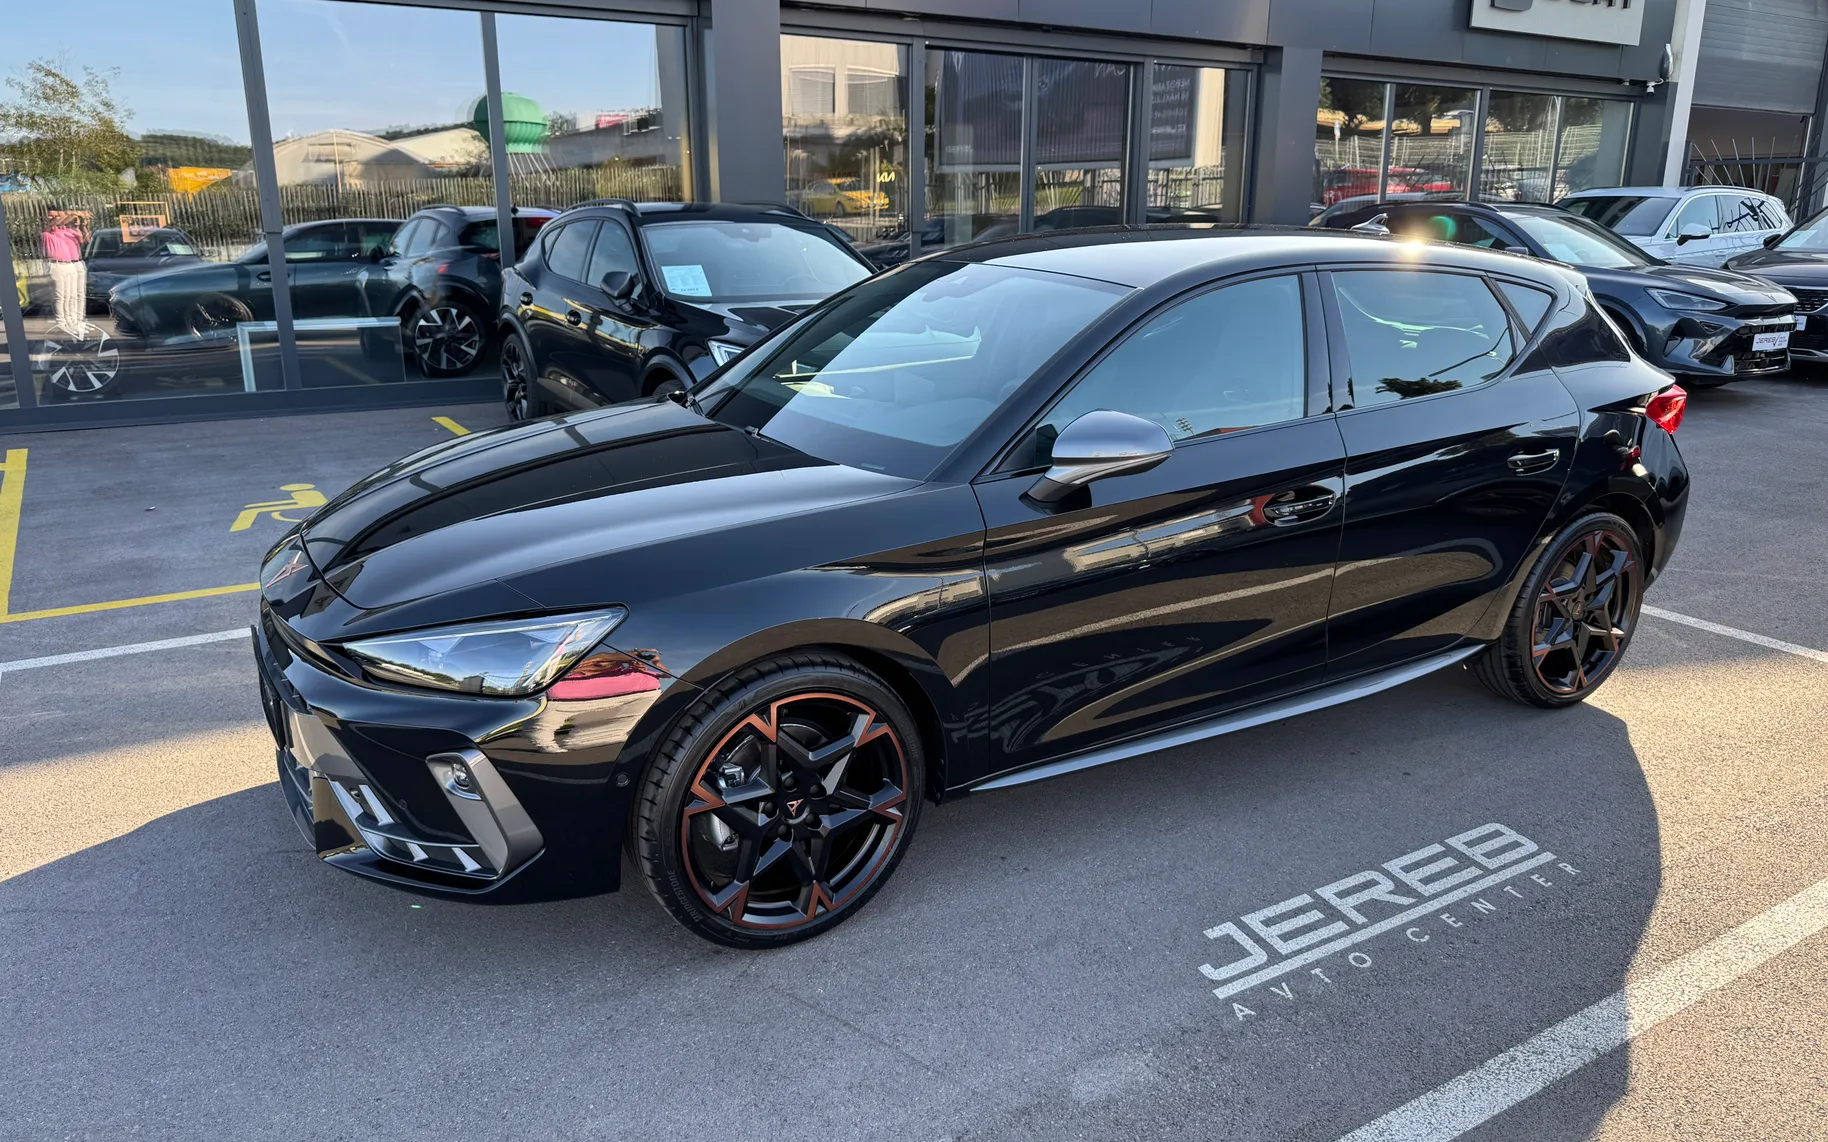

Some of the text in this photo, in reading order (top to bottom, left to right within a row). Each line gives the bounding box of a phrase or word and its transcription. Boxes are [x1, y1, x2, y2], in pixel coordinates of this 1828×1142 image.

[1198, 822, 1539, 980] JEREB
[1231, 862, 1581, 1020] AVTO CENTER
